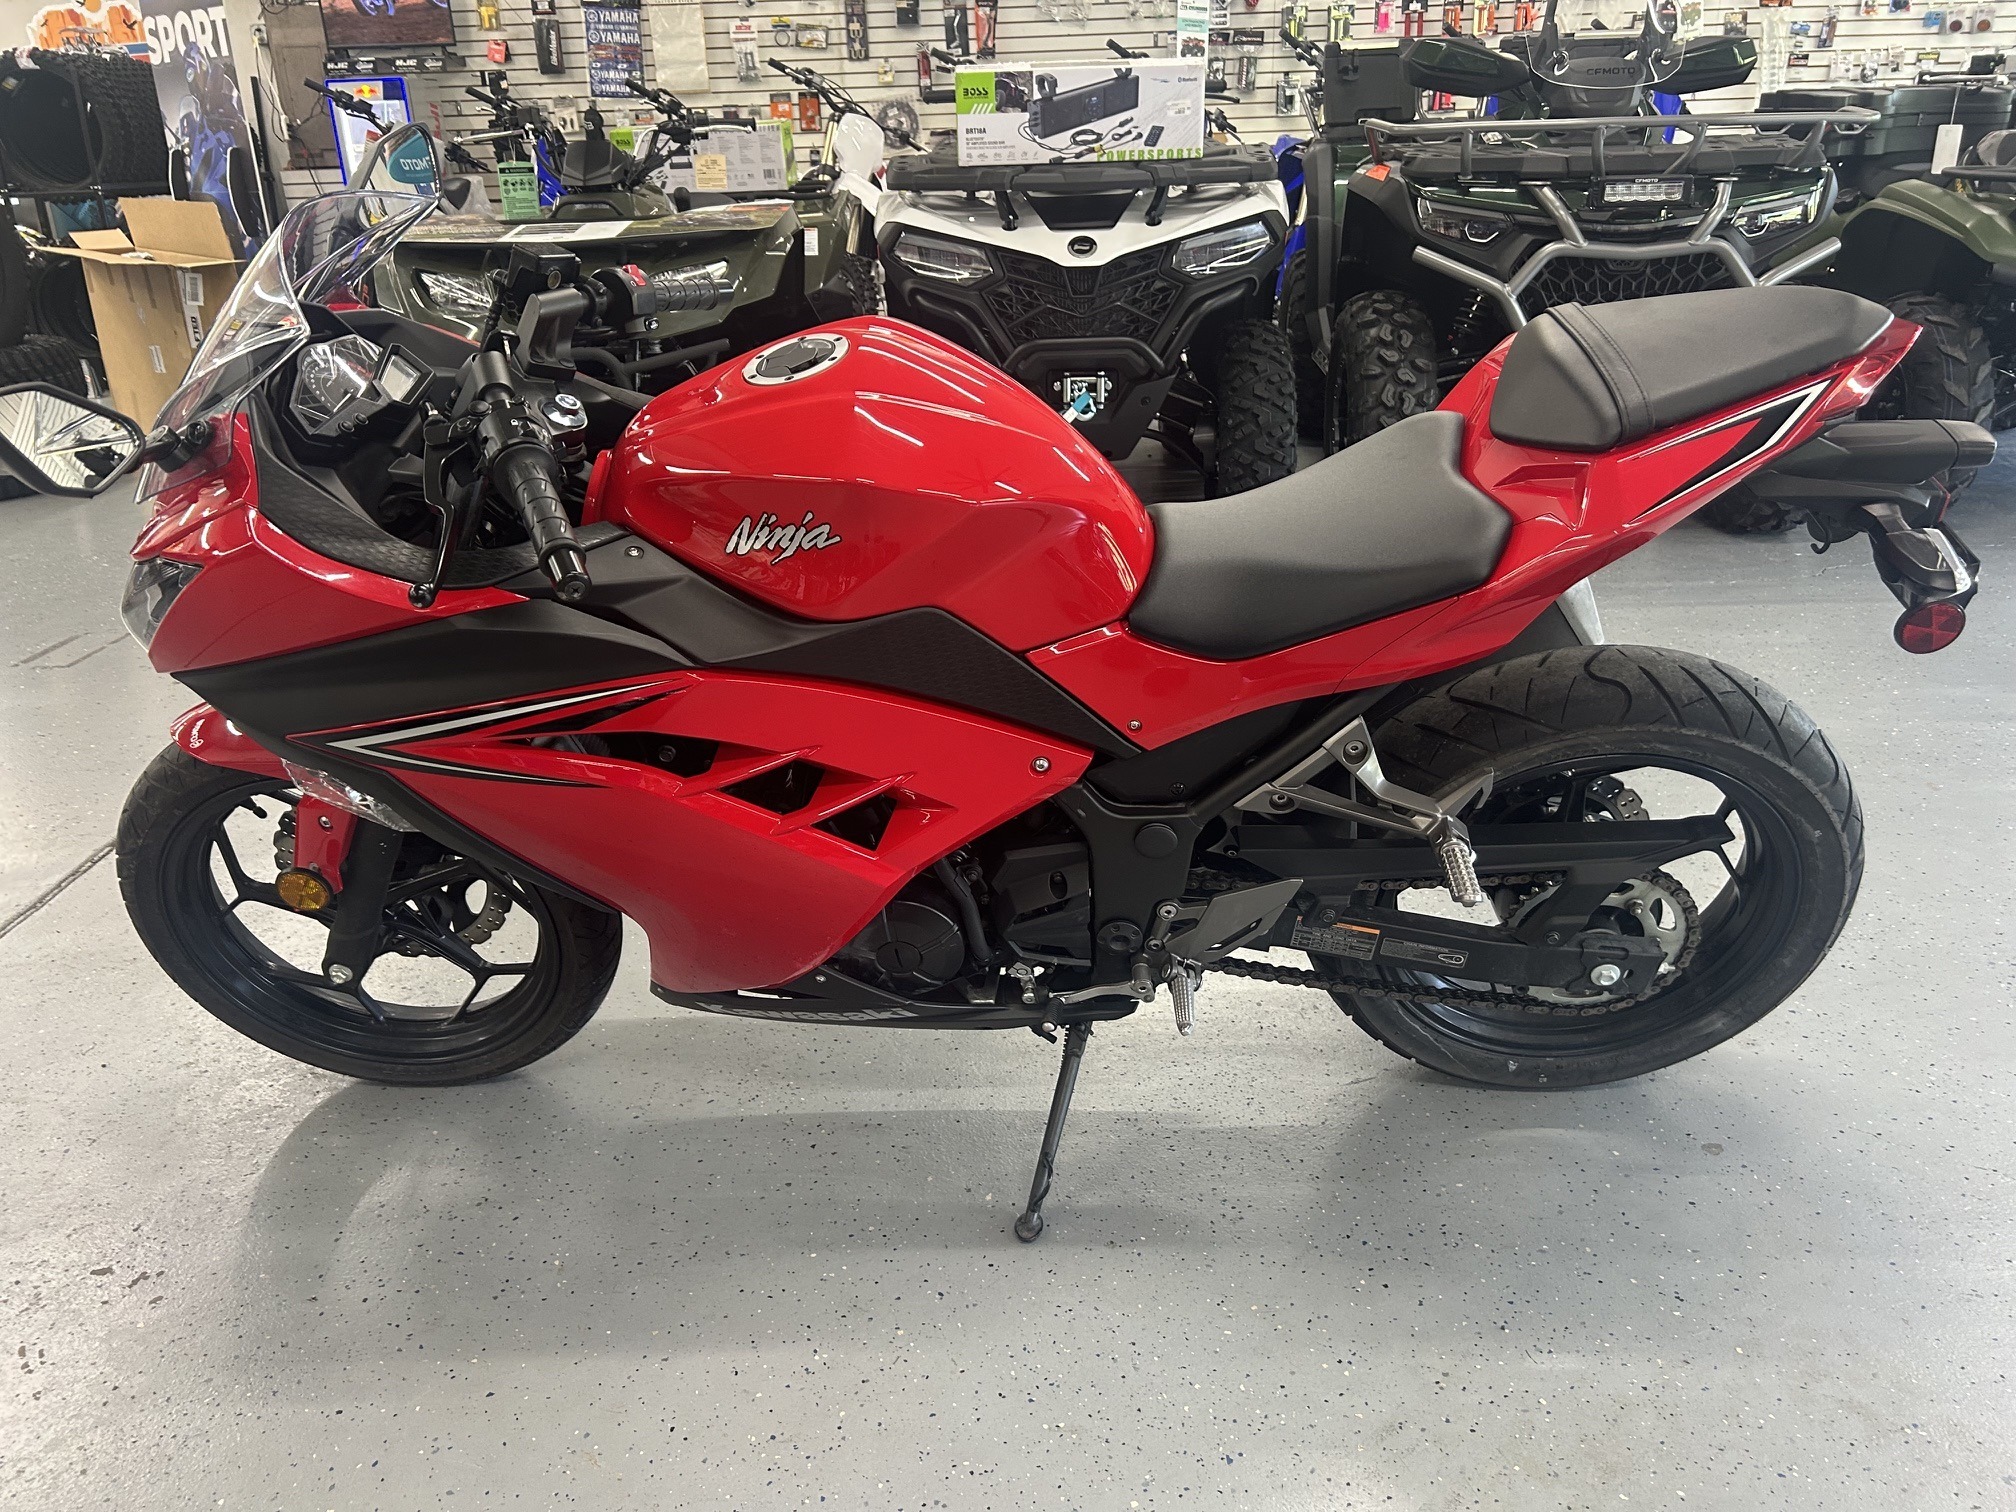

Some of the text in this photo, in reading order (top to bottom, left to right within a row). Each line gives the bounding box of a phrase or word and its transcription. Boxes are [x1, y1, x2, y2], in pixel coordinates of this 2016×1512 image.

[599, 10, 639, 23] YAMAHA
[143, 6, 229, 65] SPORT
[600, 31, 641, 44] YAMAHA
[600, 70, 630, 79] YAMAHA
[1586, 67, 1635, 76] CFMOTO
[601, 84, 631, 93] YAMAHA
[963, 87, 989, 97] BOSS
[1097, 147, 1202, 162] POWERSPORTS
[725, 511, 842, 566] Ninja
[695, 1001, 919, 1021] Kawasaki
